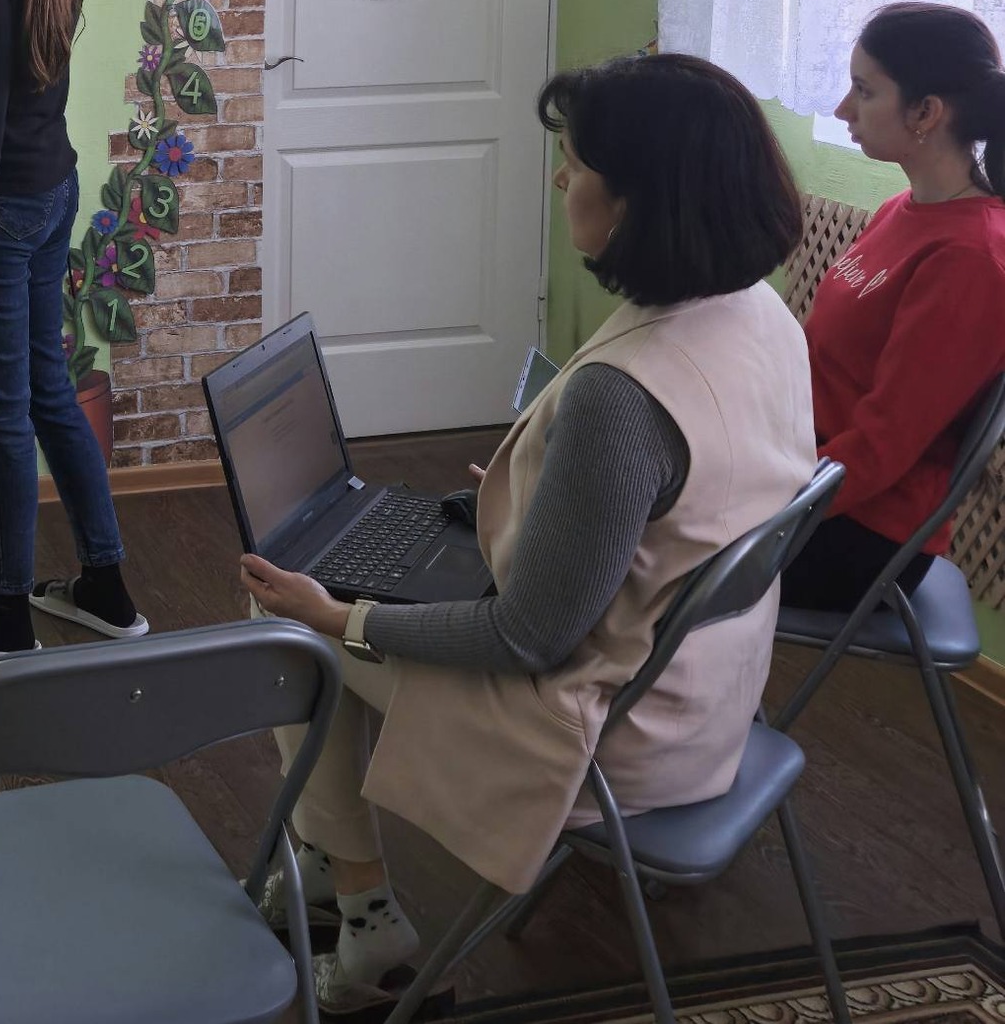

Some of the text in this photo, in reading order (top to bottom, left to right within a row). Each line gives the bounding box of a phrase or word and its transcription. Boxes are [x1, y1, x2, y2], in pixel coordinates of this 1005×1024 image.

[180, 71, 202, 105] 4
[149, 186, 174, 218] 3
[121, 244, 149, 278] 2
[107, 298, 118, 331] 1
